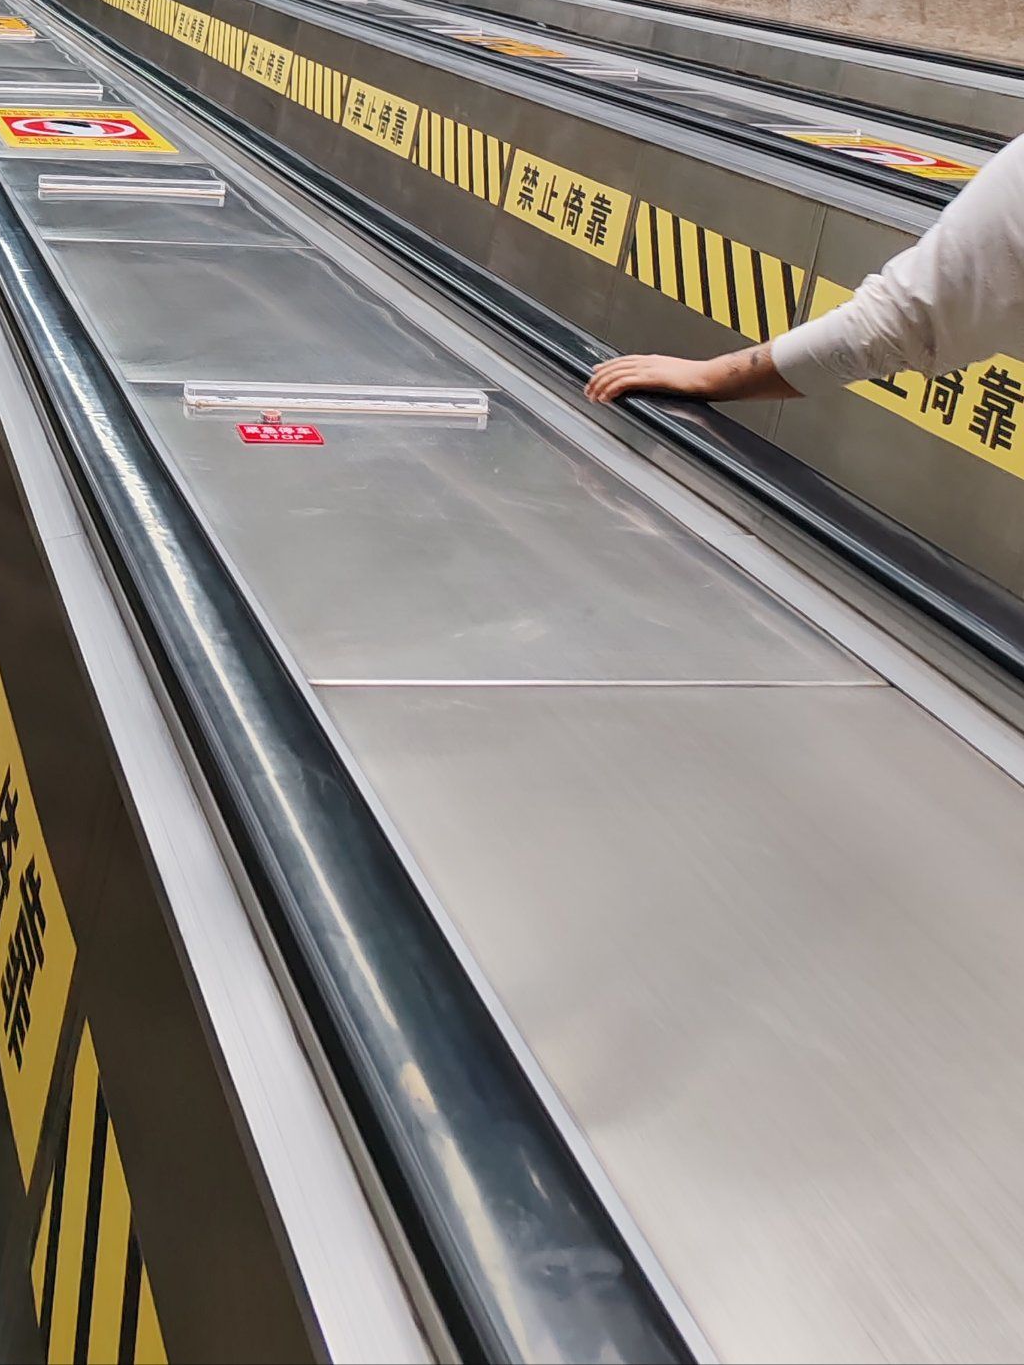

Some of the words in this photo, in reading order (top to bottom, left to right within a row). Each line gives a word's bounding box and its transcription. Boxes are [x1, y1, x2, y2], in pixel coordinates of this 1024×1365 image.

[350, 88, 408, 147] 禁止倚靠
[516, 161, 613, 248] 禁止倚靠
